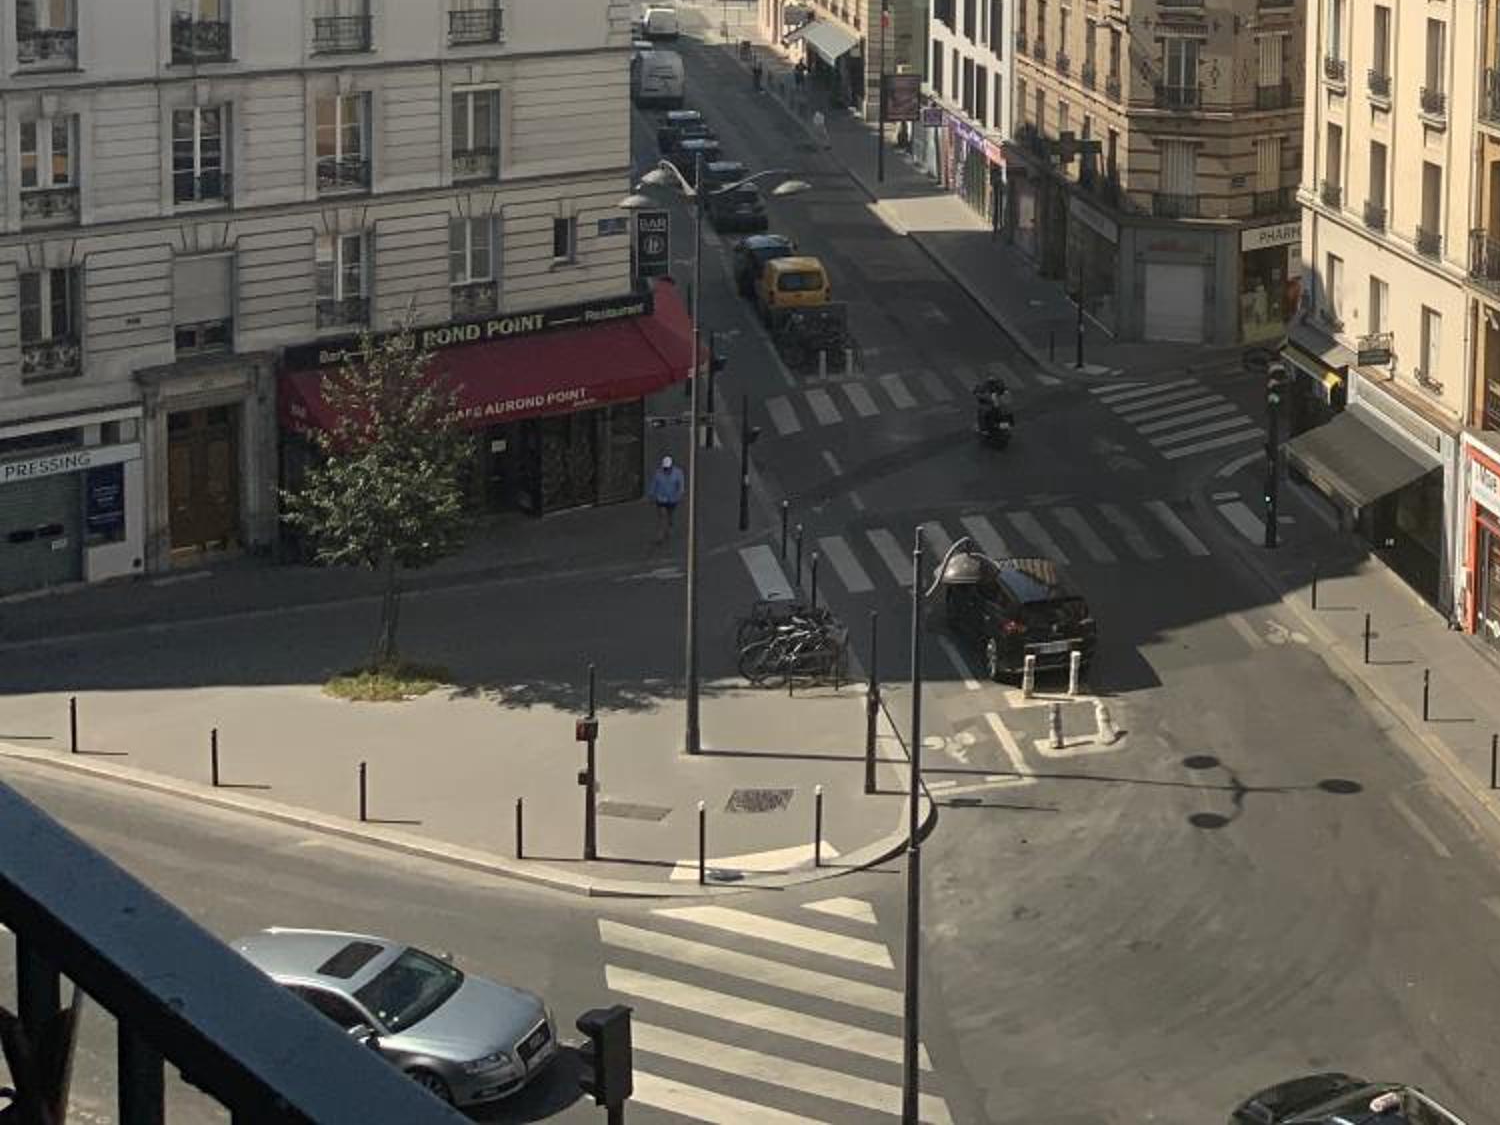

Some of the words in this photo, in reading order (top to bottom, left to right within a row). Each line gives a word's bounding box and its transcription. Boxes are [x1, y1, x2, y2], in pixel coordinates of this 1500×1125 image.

[640, 218, 666, 229] BAR
[486, 314, 545, 338] POINT
[5, 454, 92, 479] PRESSING
